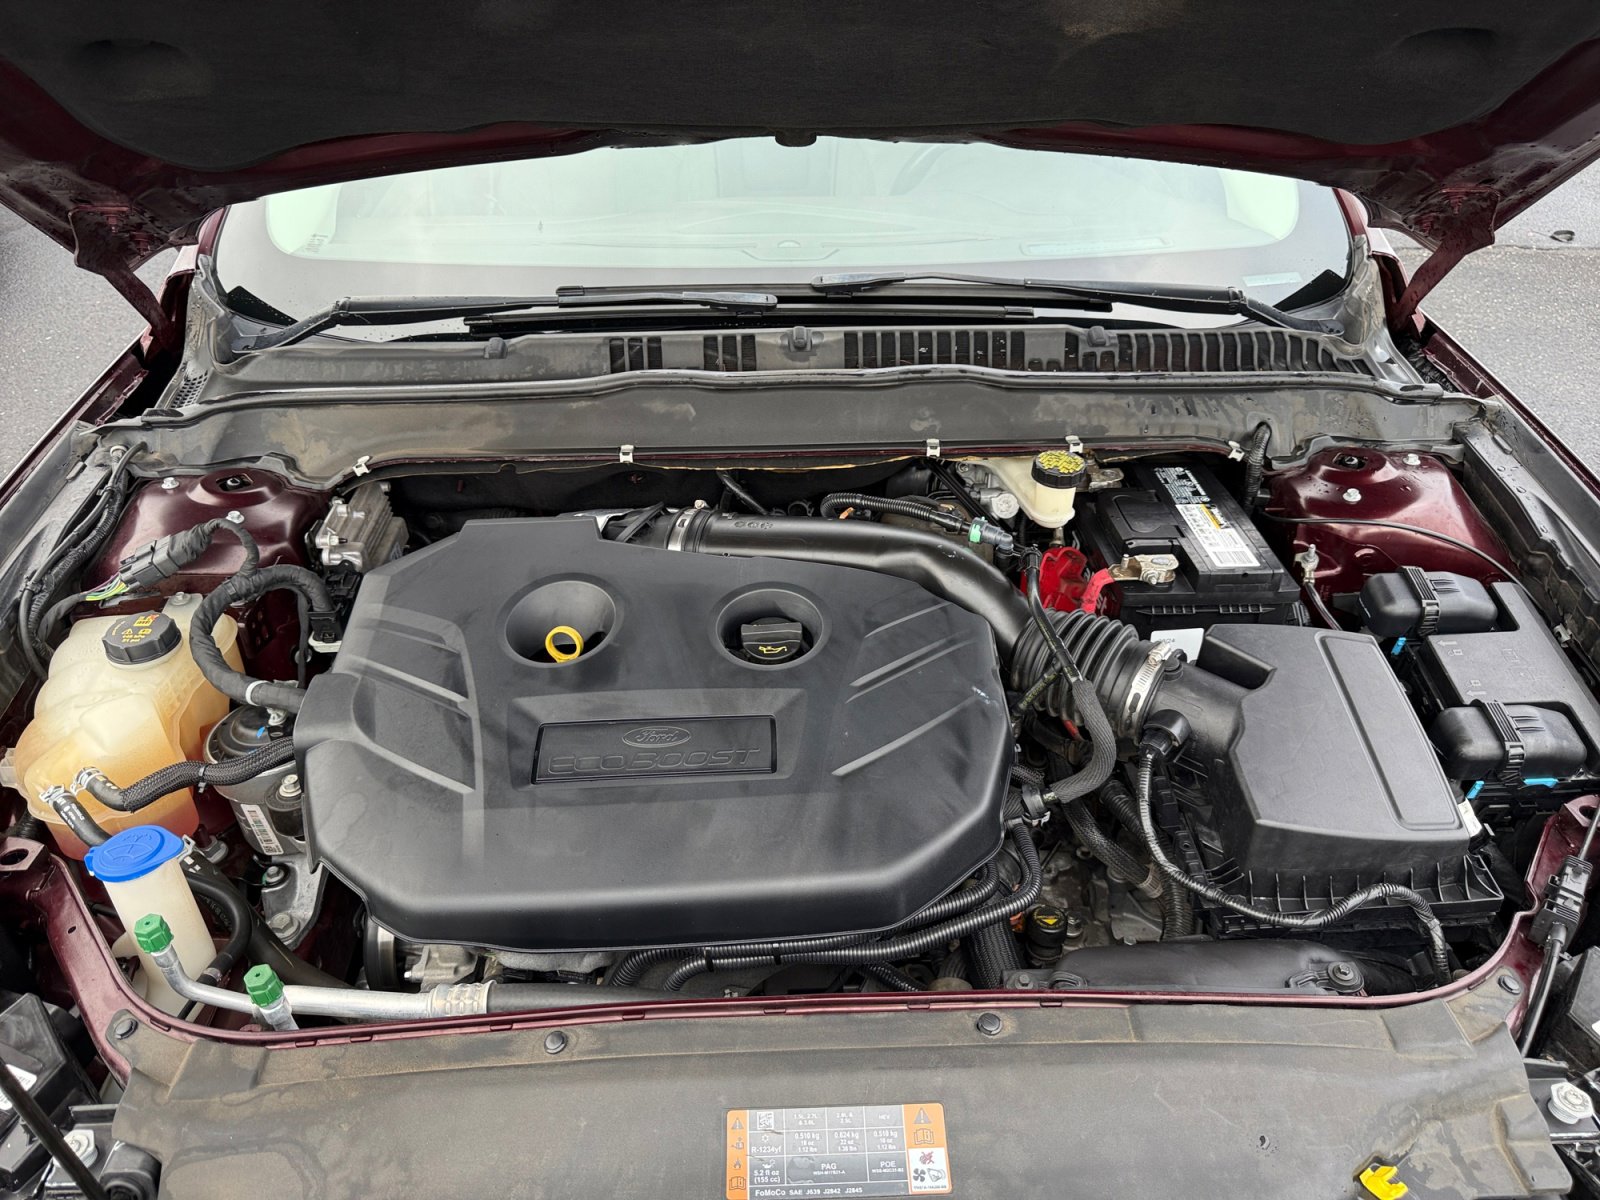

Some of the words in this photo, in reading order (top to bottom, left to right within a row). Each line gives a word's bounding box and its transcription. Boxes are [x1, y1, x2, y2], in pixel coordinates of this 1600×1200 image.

[635, 728, 679, 743] Ford
[548, 748, 760, 775] ECOBOOST
[812, 1132, 820, 1141] kg
[850, 1131, 859, 1139] kg
[890, 1130, 898, 1138] kg
[751, 1146, 782, 1154] R-1234yf
